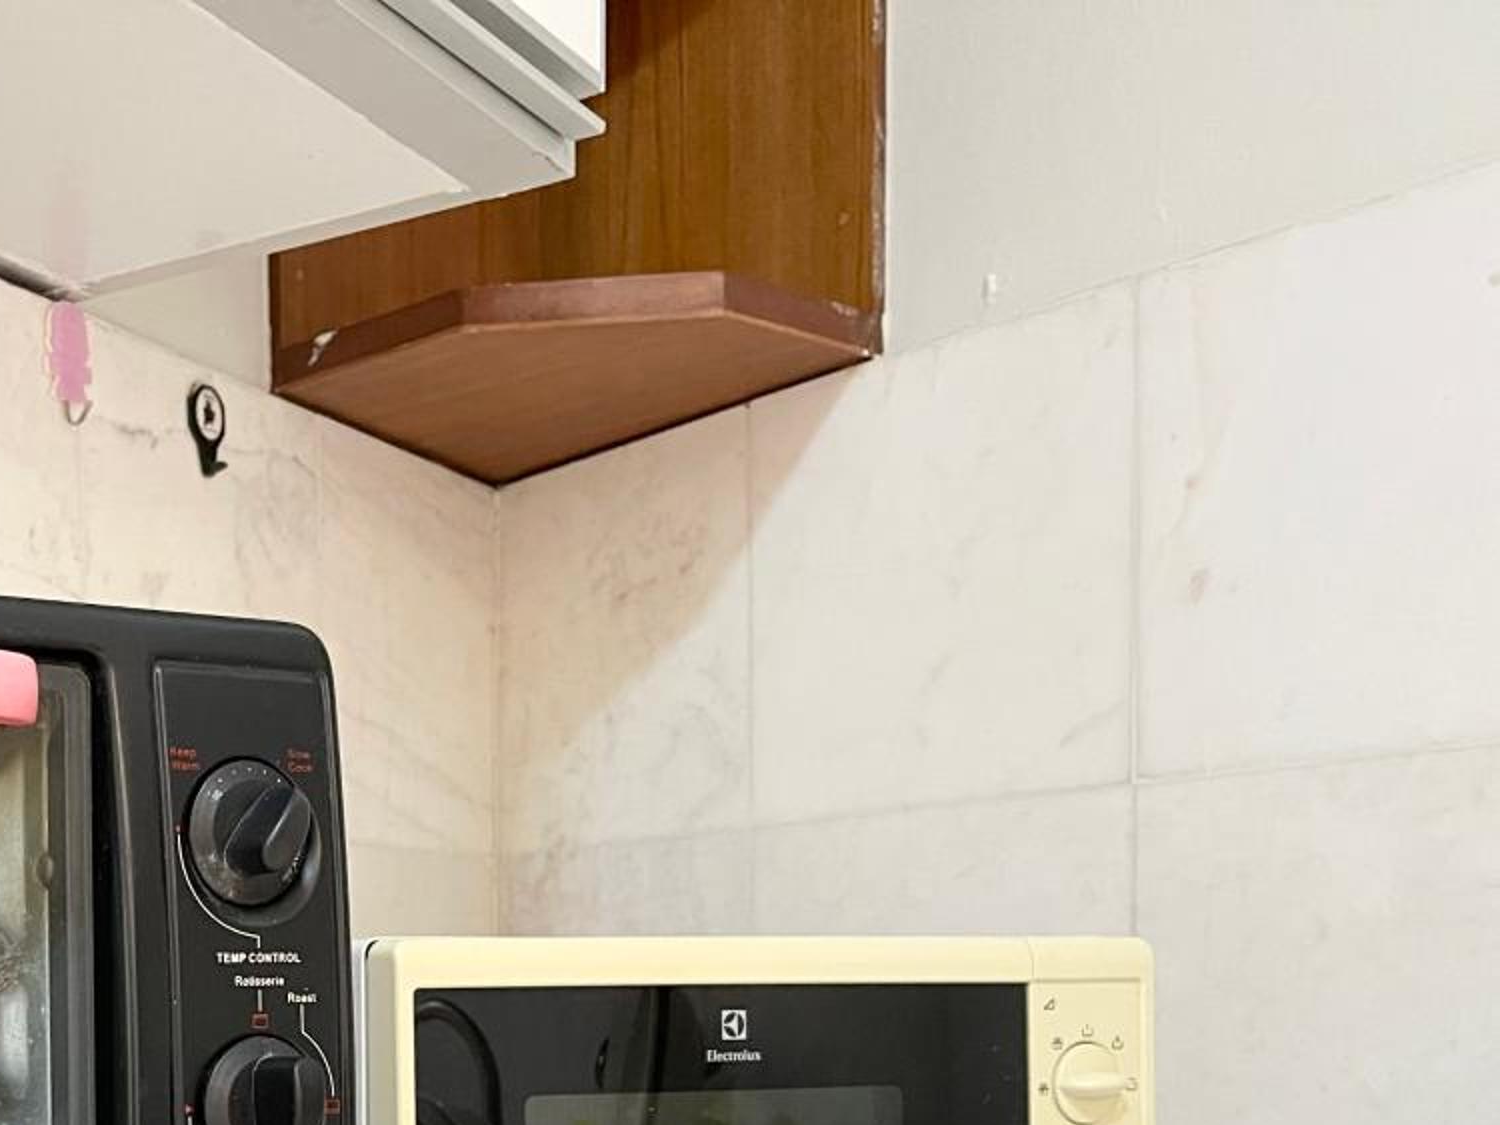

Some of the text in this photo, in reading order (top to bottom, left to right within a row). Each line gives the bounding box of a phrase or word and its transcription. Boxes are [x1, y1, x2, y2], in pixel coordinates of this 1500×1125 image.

[217, 951, 302, 964] TEMP CONTROL
[706, 1048, 762, 1063] Electrolux
